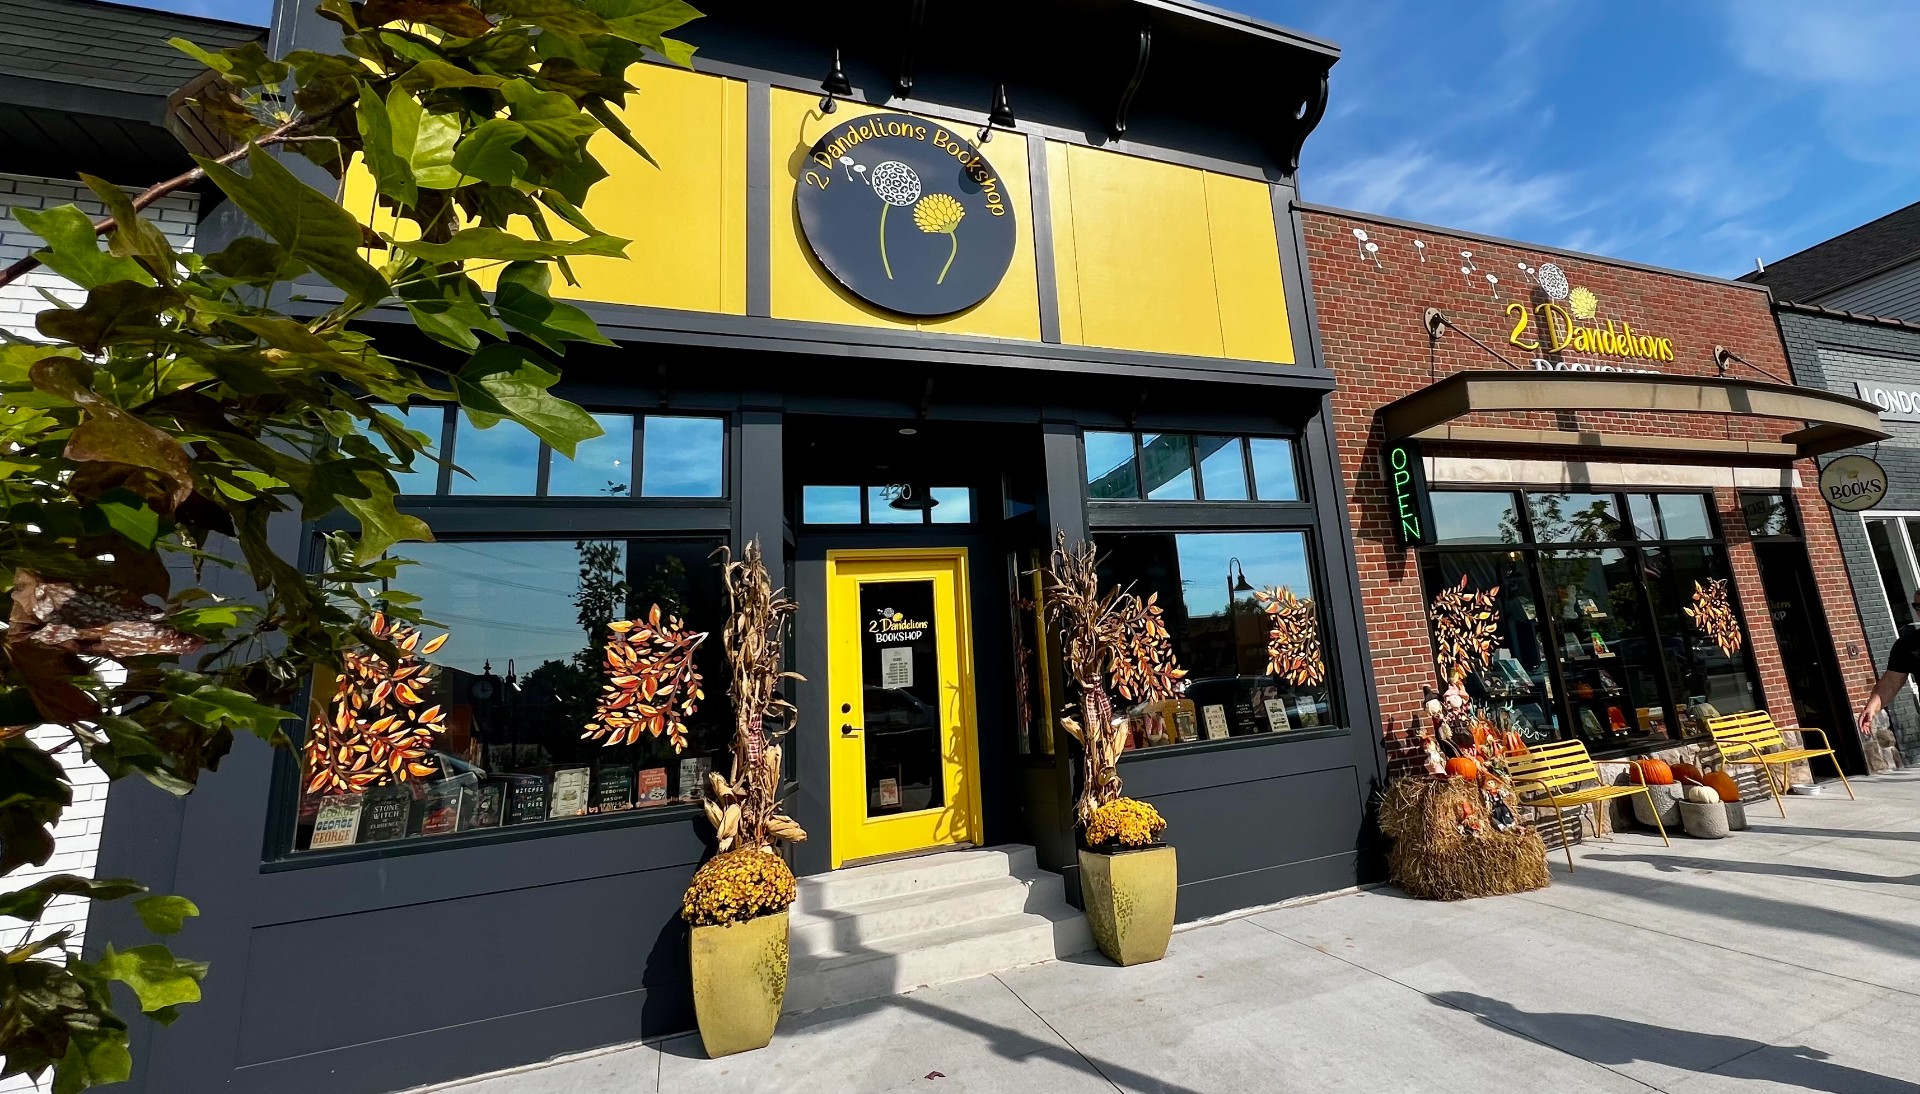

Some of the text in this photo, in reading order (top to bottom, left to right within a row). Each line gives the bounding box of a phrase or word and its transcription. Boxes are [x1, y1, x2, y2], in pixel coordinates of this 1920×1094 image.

[805, 117, 1005, 217] 2 Dandelions Bookshop
[1505, 303, 1675, 363] 2 Dandelions
[878, 483, 912, 501] 430
[1392, 448, 1421, 542] OPEN
[1829, 478, 1882, 500] BOOKS
[868, 618, 929, 633] 2 Dandelions
[875, 630, 922, 643] BOOKSHOP
[515, 786, 544, 794] WITCHES
[319, 807, 355, 819] GEORGE
[373, 803, 400, 813] STONE
[373, 811, 400, 820] WITCH
[315, 818, 353, 831] GEORGE
[313, 830, 351, 844] GEORGE
